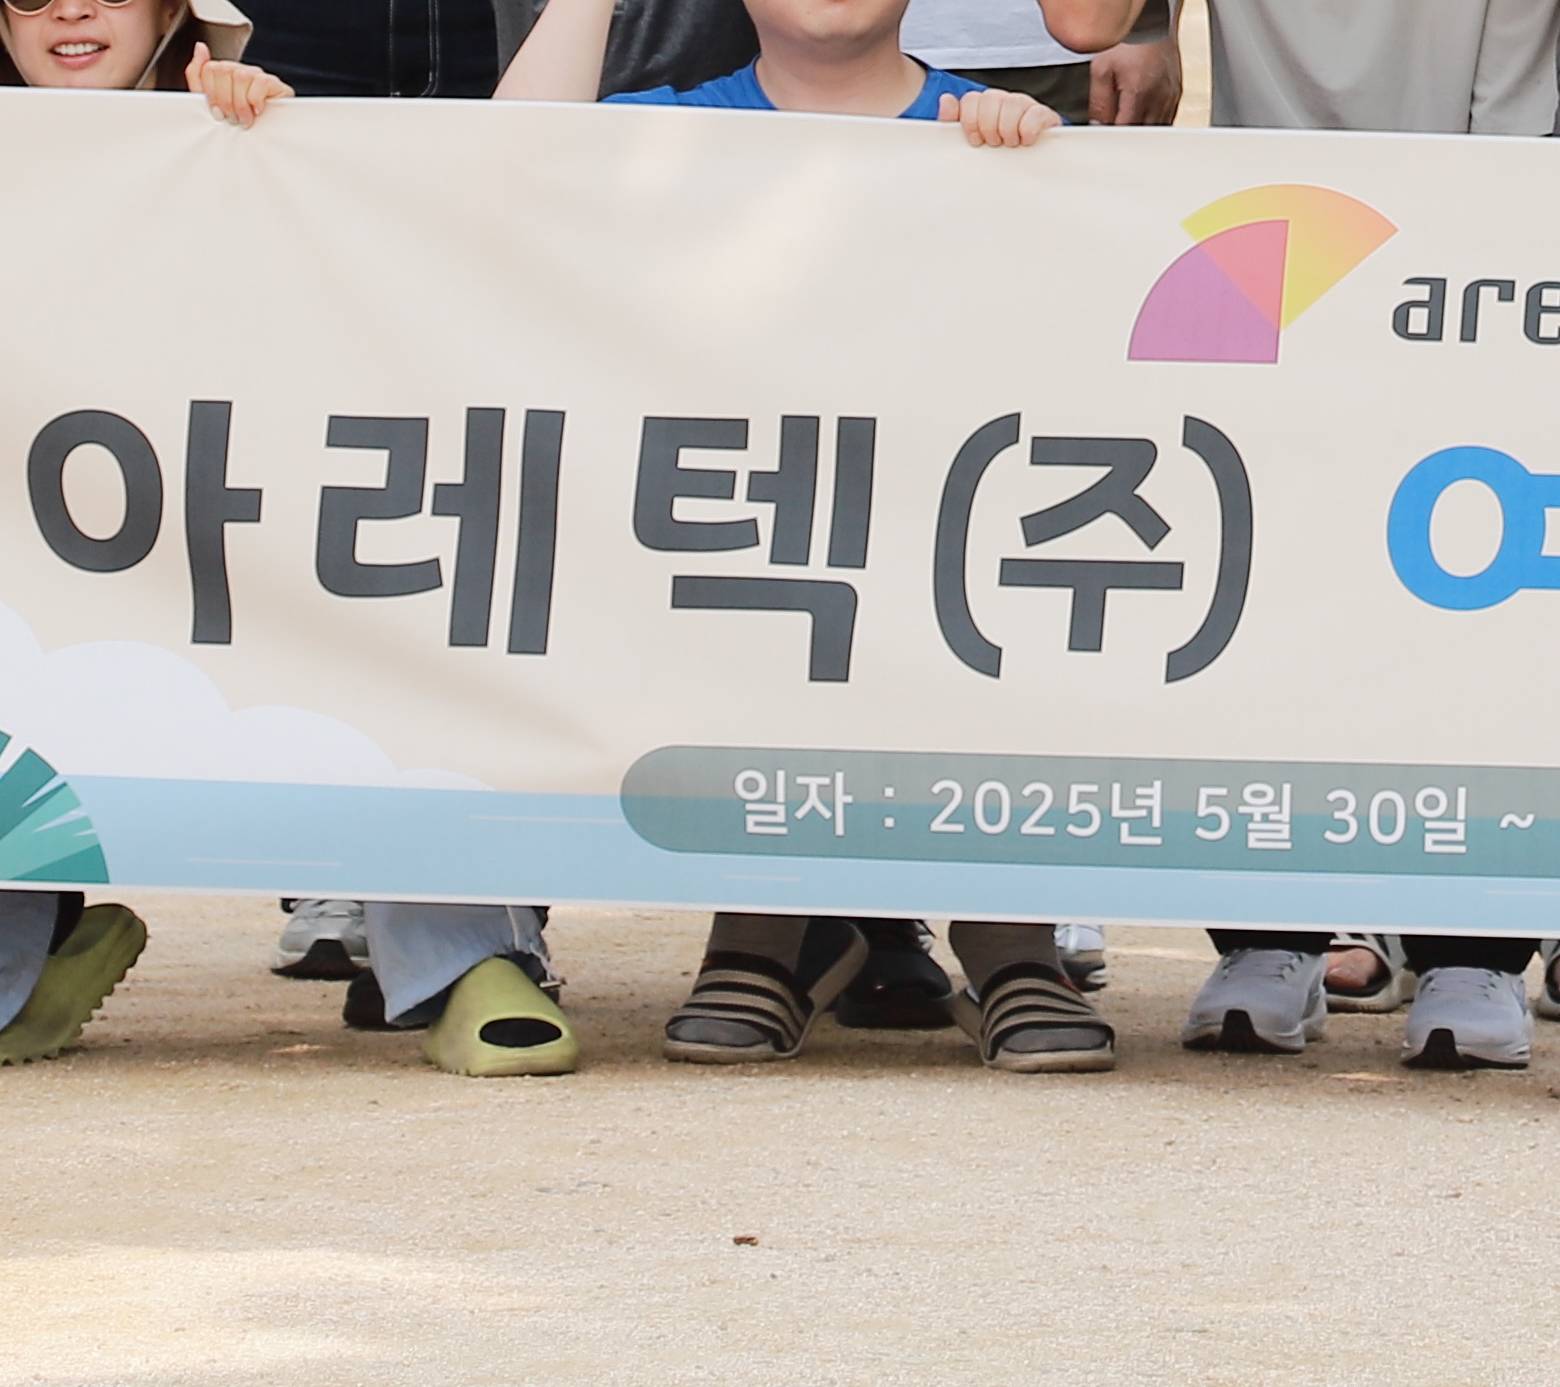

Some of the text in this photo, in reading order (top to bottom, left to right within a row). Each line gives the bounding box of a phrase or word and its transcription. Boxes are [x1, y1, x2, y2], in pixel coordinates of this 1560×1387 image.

[27, 400, 1254, 685] 아레텍(주)
[733, 768, 853, 836] 일자
[929, 778, 1165, 846] 2025년
[1194, 781, 1293, 850] 5월
[1323, 785, 1468, 854] 30일
